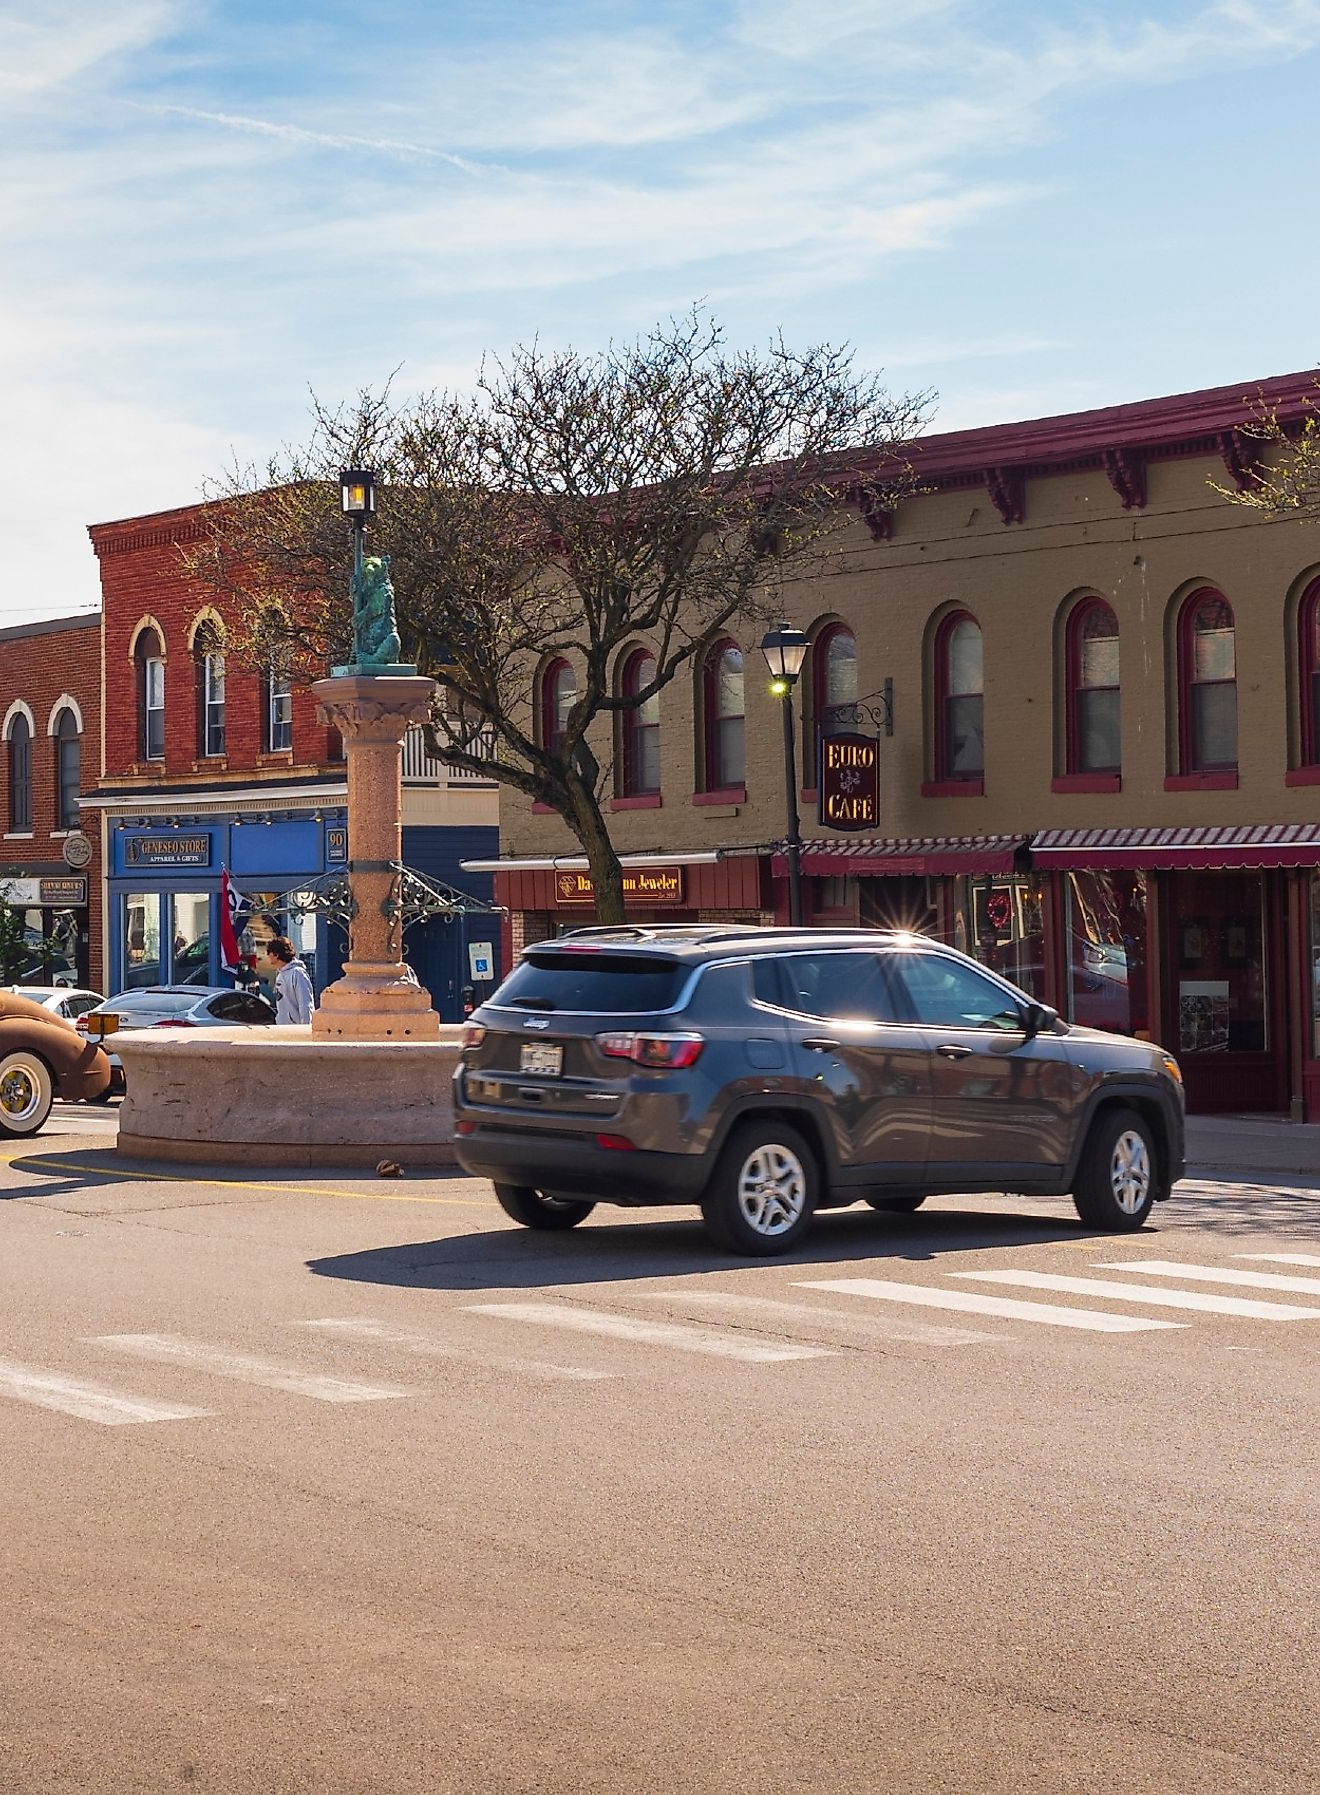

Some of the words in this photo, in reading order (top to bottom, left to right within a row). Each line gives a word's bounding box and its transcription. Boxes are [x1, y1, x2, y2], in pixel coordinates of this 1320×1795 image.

[827, 745, 874, 768] EURO
[827, 794, 873, 820] CAFÉ
[141, 841, 179, 854] GENESEO
[180, 840, 206, 853] STORE
[330, 833, 343, 846] 90
[638, 874, 678, 890] Jeweler
